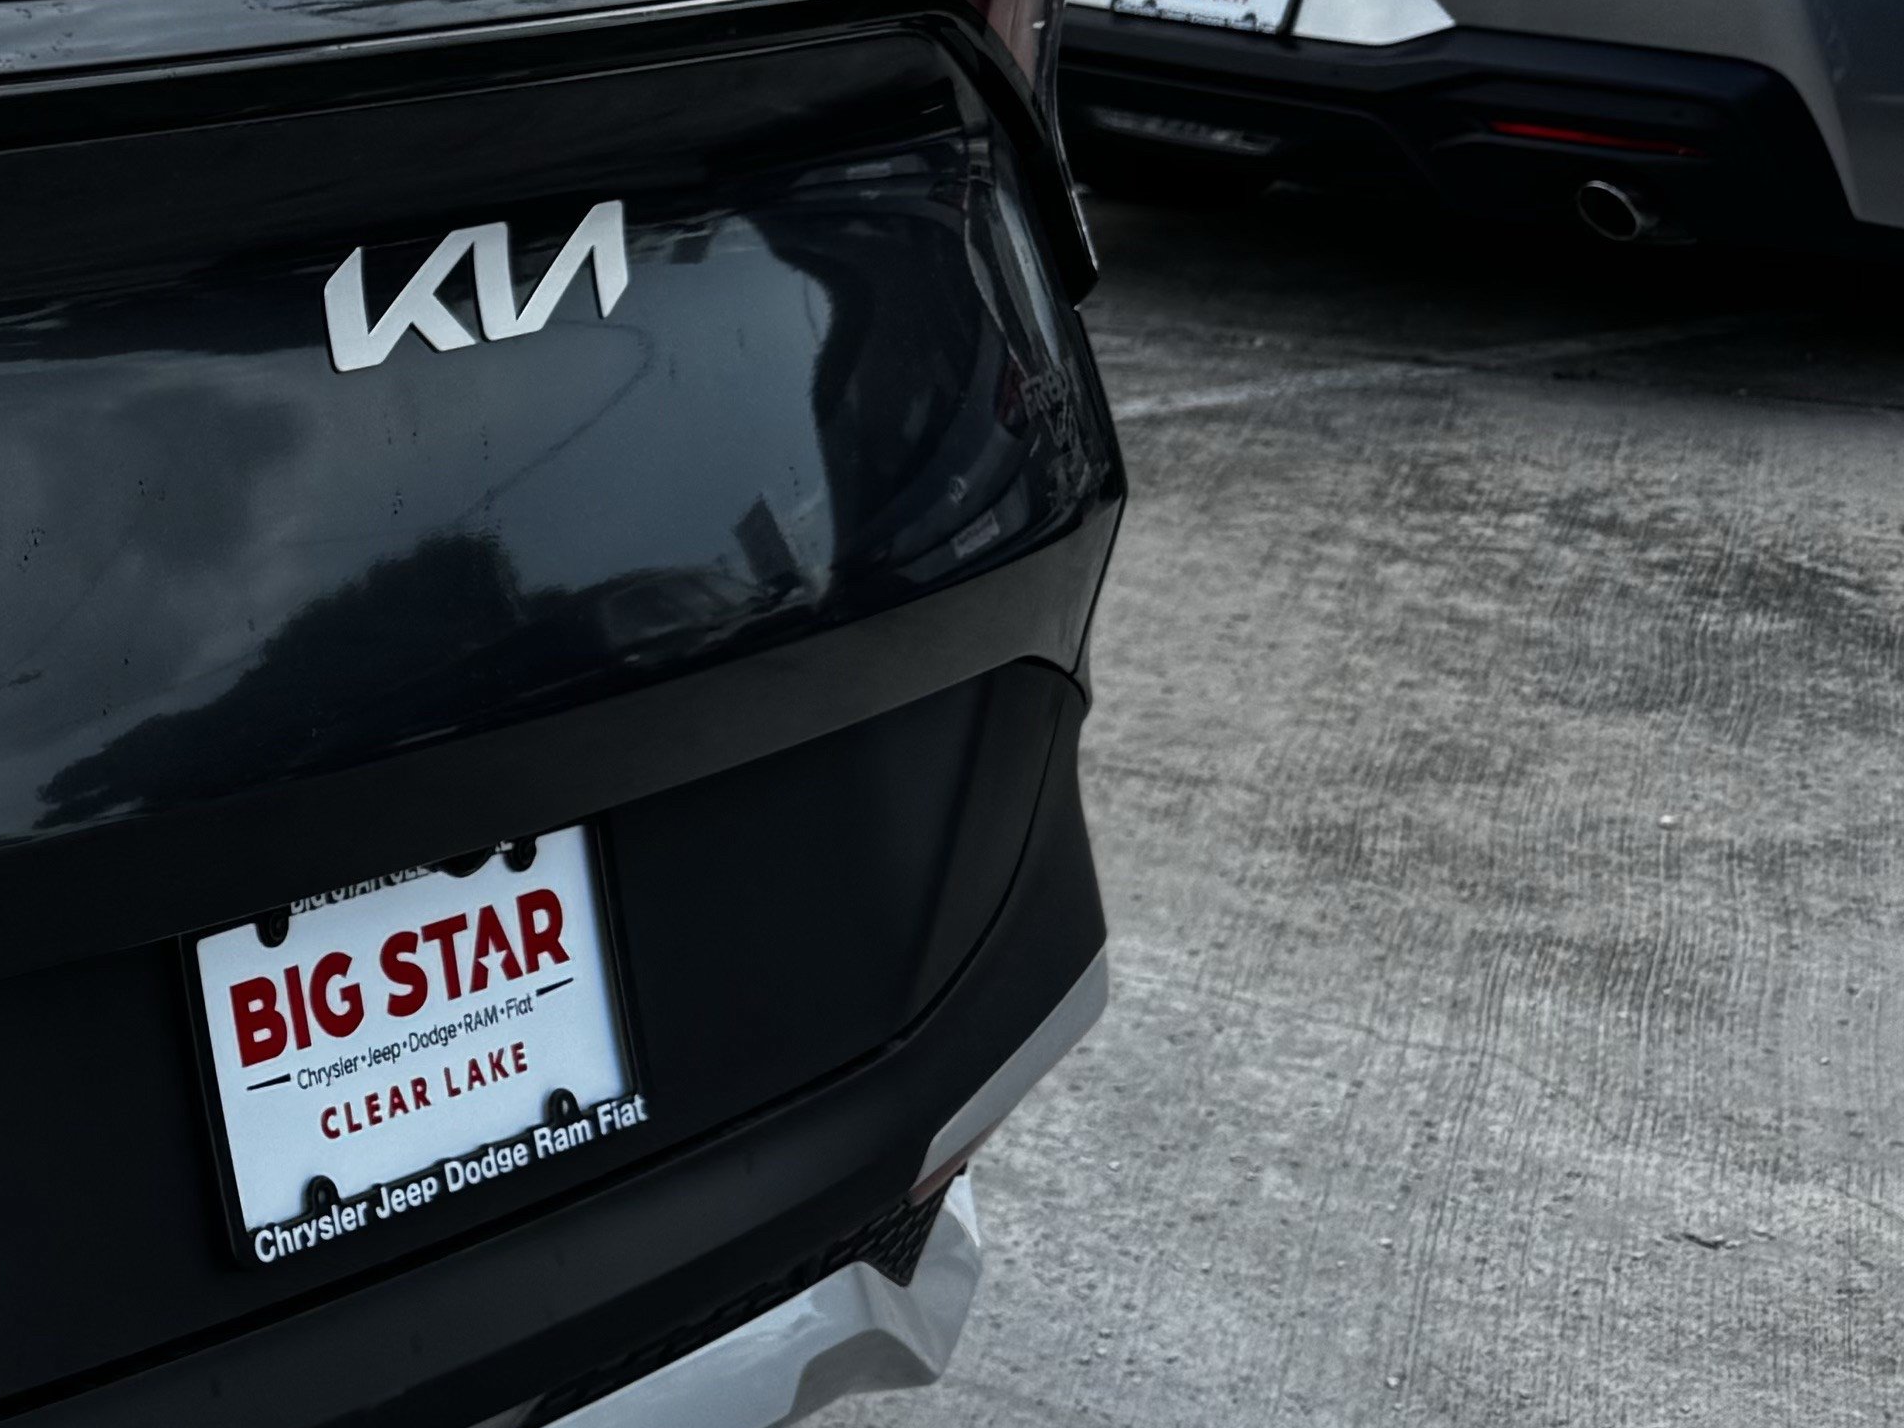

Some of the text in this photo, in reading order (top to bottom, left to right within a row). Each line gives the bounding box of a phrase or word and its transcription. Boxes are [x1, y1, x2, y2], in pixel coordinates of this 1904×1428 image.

[229, 951, 365, 1068] BIG
[380, 888, 571, 1018] STAR
[320, 1040, 528, 1140] CLEAR LAKE
[254, 1093, 650, 1263] Chrysler Jeep Dodge Ram Fiat
